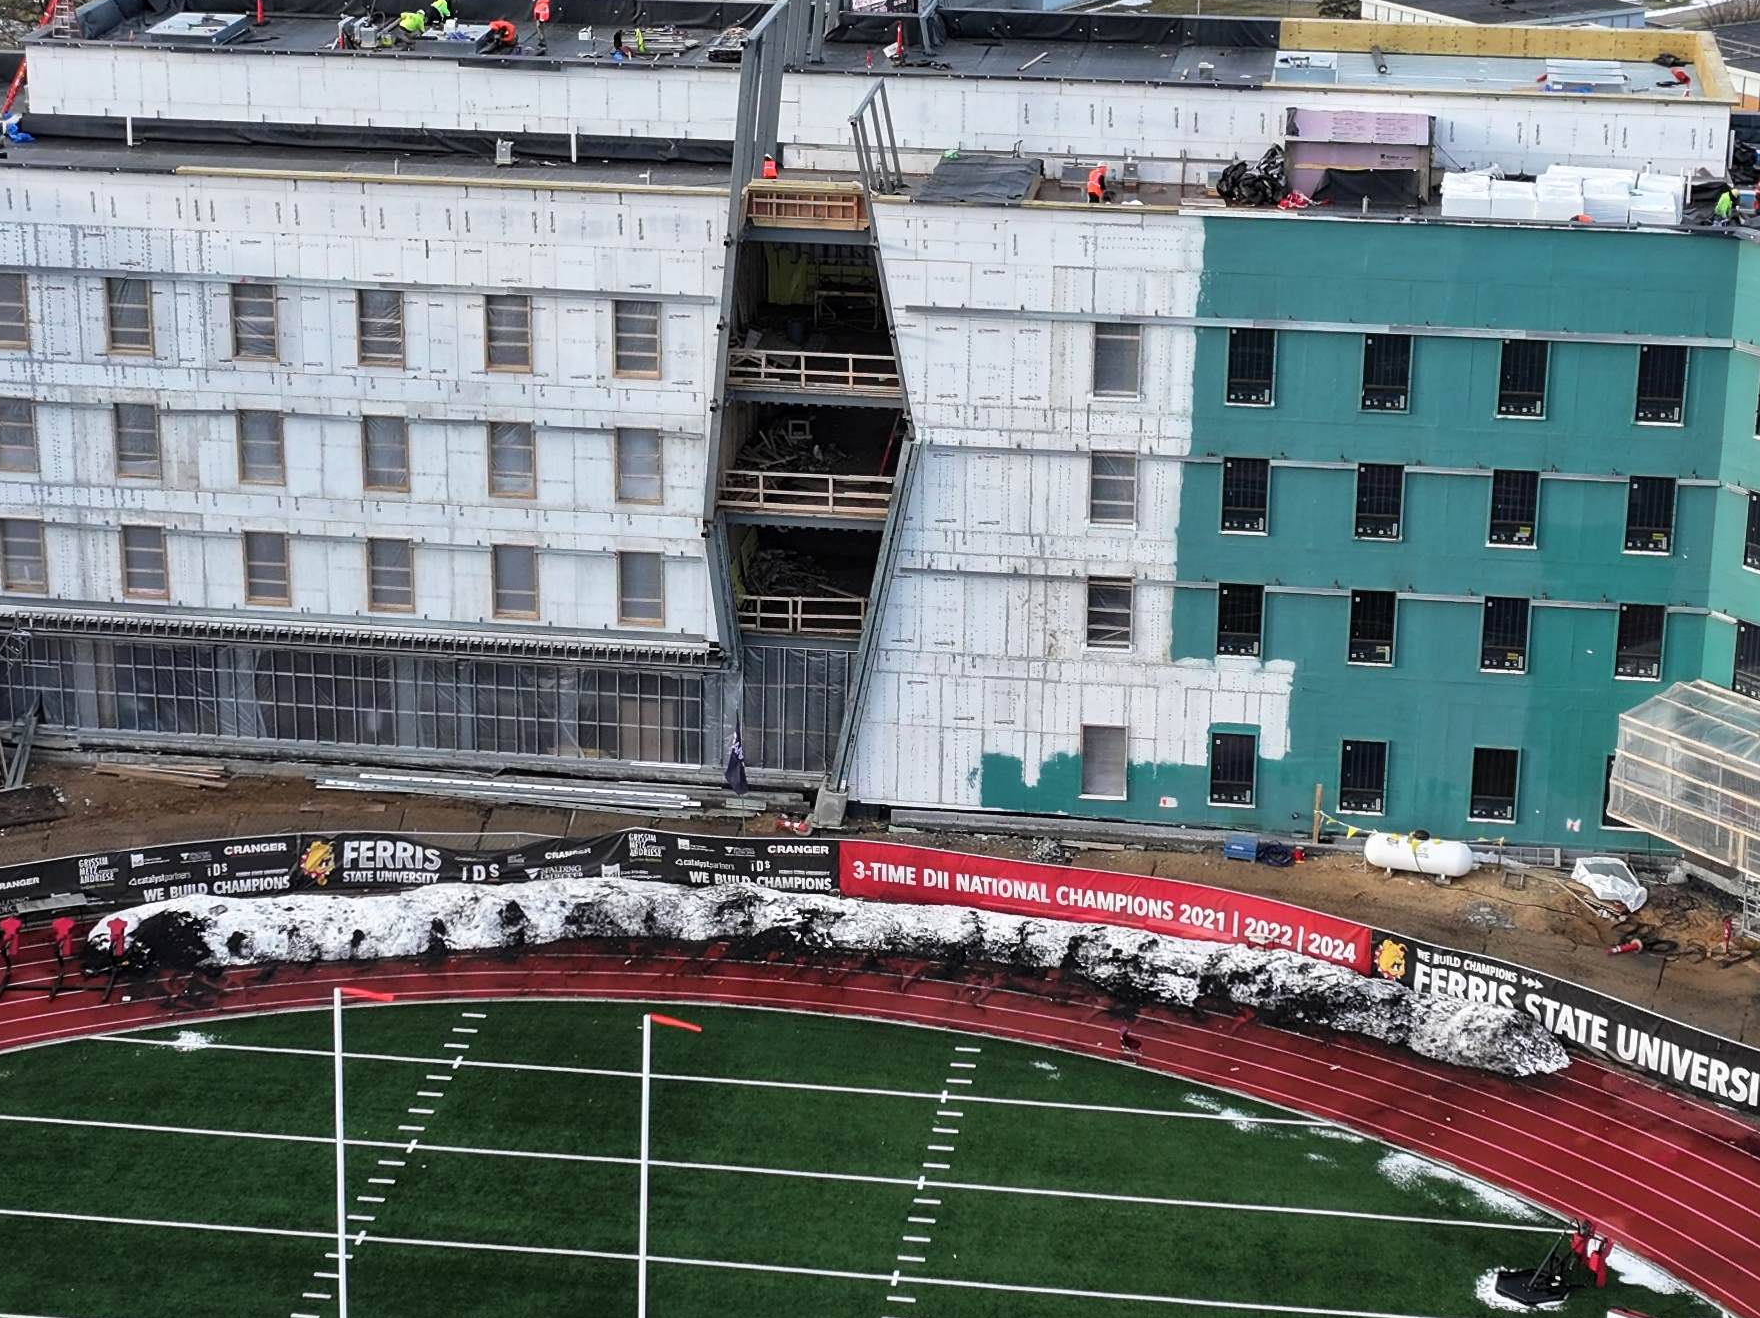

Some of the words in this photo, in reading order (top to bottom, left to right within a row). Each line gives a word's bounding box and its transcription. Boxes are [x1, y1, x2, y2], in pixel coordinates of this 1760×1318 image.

[343, 840, 442, 870] FERRIS
[143, 887, 165, 903] WE
[170, 882, 208, 899] BUILD
[213, 875, 290, 895] CHAMPIONS
[342, 870, 374, 883] STATE
[376, 871, 441, 885] UNIVERSITY
[689, 871, 710, 884] WE
[714, 872, 752, 885] BUILD
[757, 876, 832, 891] CHAMPIONS
[853, 860, 917, 887] 3-TIME
[923, 867, 950, 891] DII
[955, 873, 1051, 904] NATIONAL
[1056, 885, 1174, 921] CHAMPIONS
[1179, 903, 1225, 932] 2021
[1244, 917, 1293, 946] 2022
[1307, 932, 1357, 963] 2024
[1416, 948, 1430, 963] WE
[1433, 952, 1462, 969] BUILD
[1463, 959, 1518, 983] CHAMPIONS
[1526, 994, 1607, 1052] STATE
